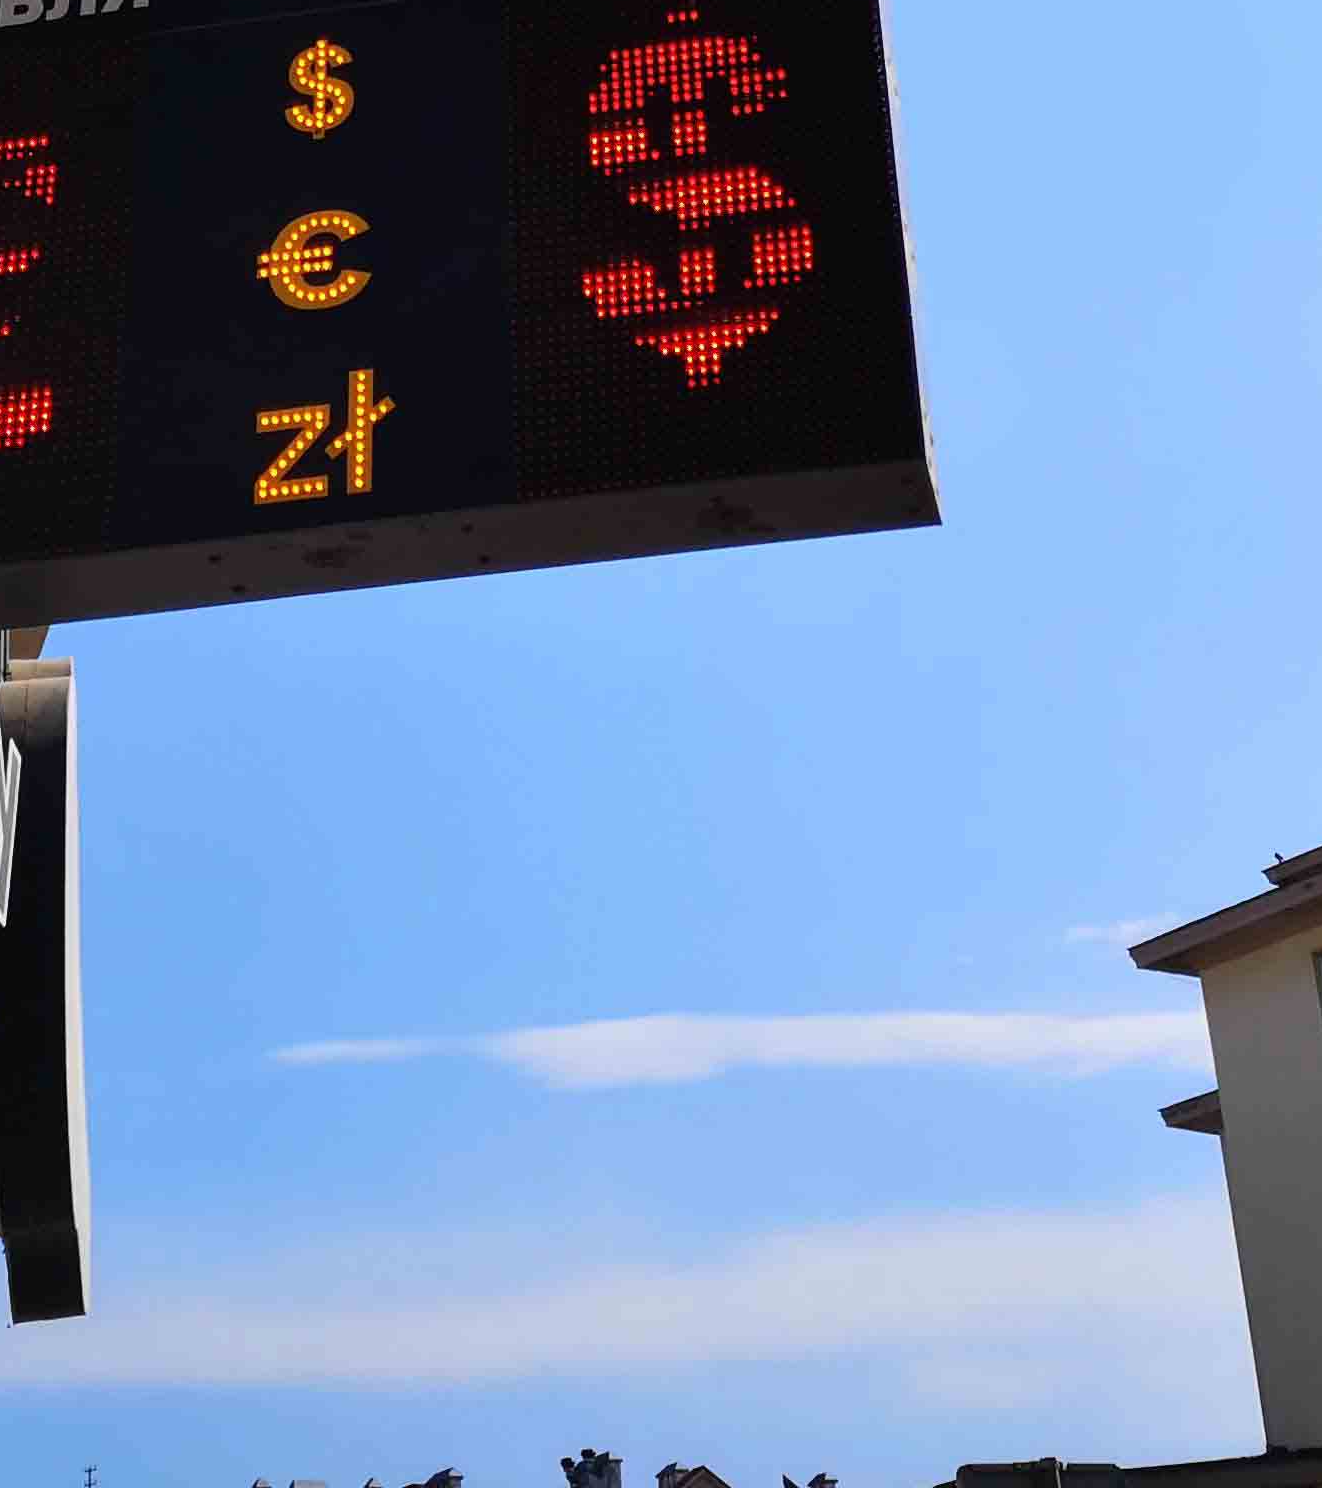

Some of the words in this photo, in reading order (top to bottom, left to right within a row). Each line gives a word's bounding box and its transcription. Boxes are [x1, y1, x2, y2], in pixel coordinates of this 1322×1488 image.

[285, 38, 355, 138] $
[257, 209, 371, 310] €
[254, 370, 396, 505] zł
